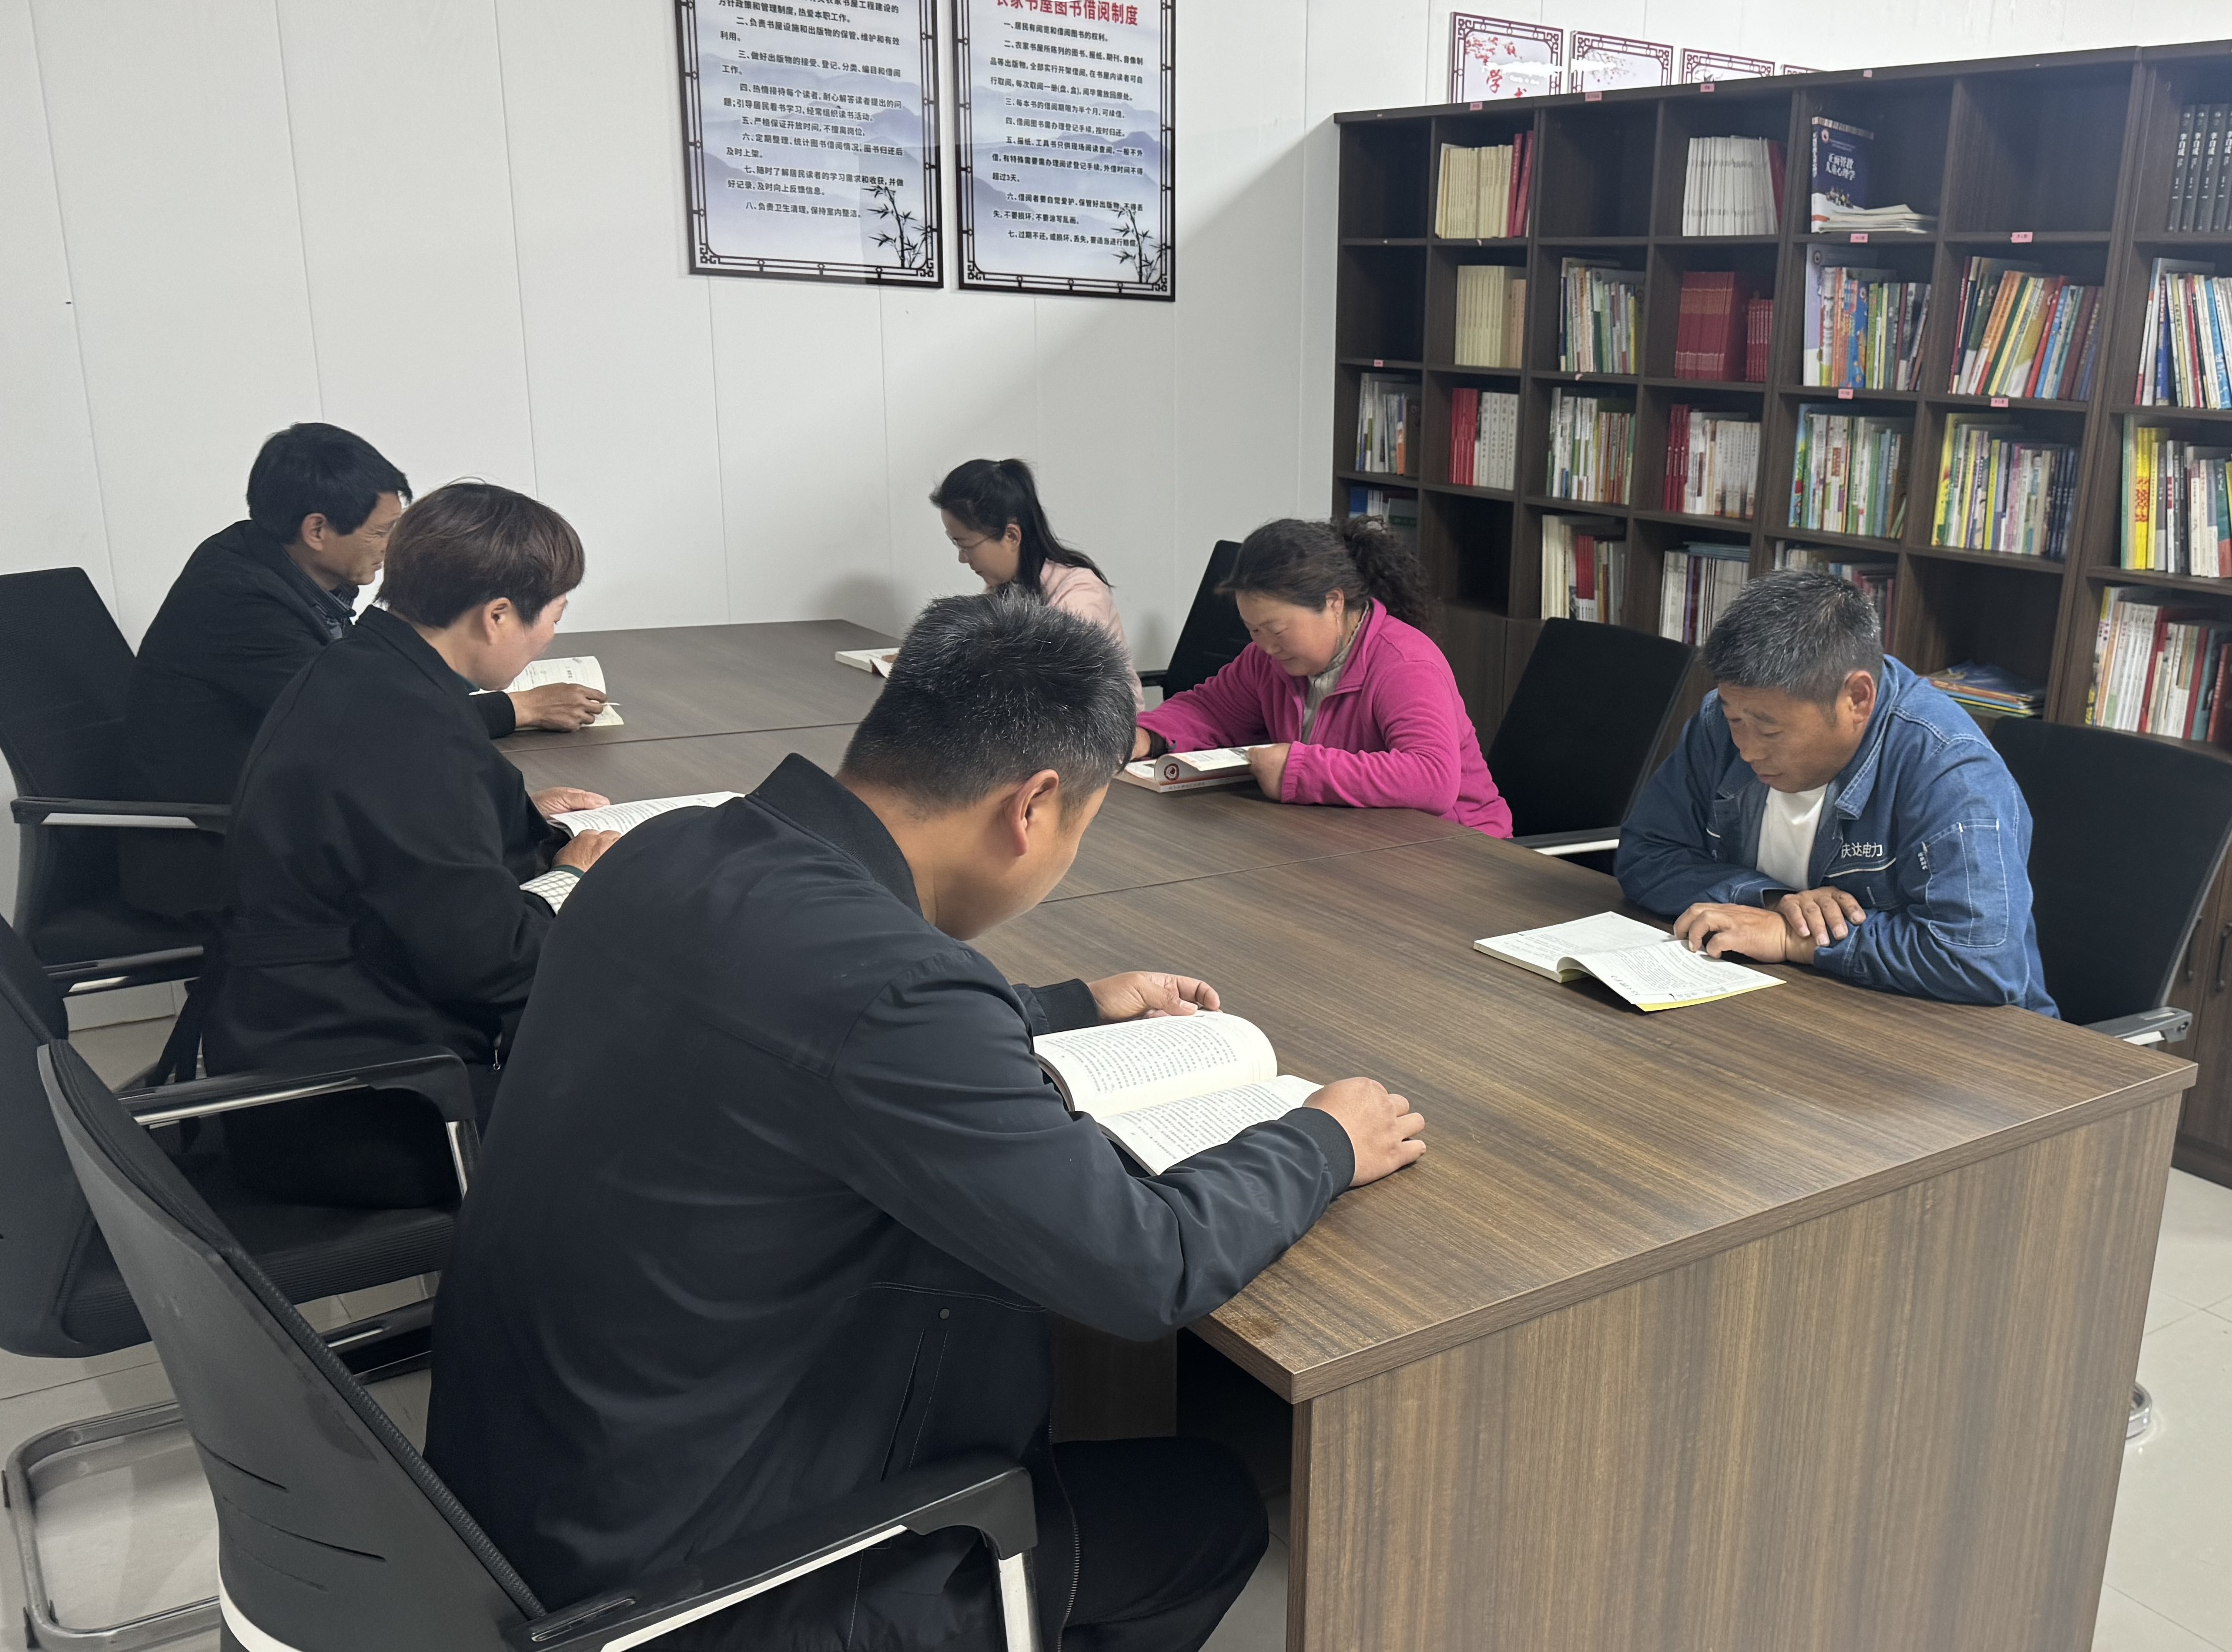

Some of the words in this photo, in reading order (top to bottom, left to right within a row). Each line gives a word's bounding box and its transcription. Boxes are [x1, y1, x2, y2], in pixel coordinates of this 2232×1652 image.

[997, 0, 1138, 26] 书屋图书借阅制度
[720, 31, 740, 41] 利用。
[722, 65, 742, 74] 工作。
[726, 147, 763, 158] 及时上架。
[1841, 842, 1883, 858] 庆达电力
